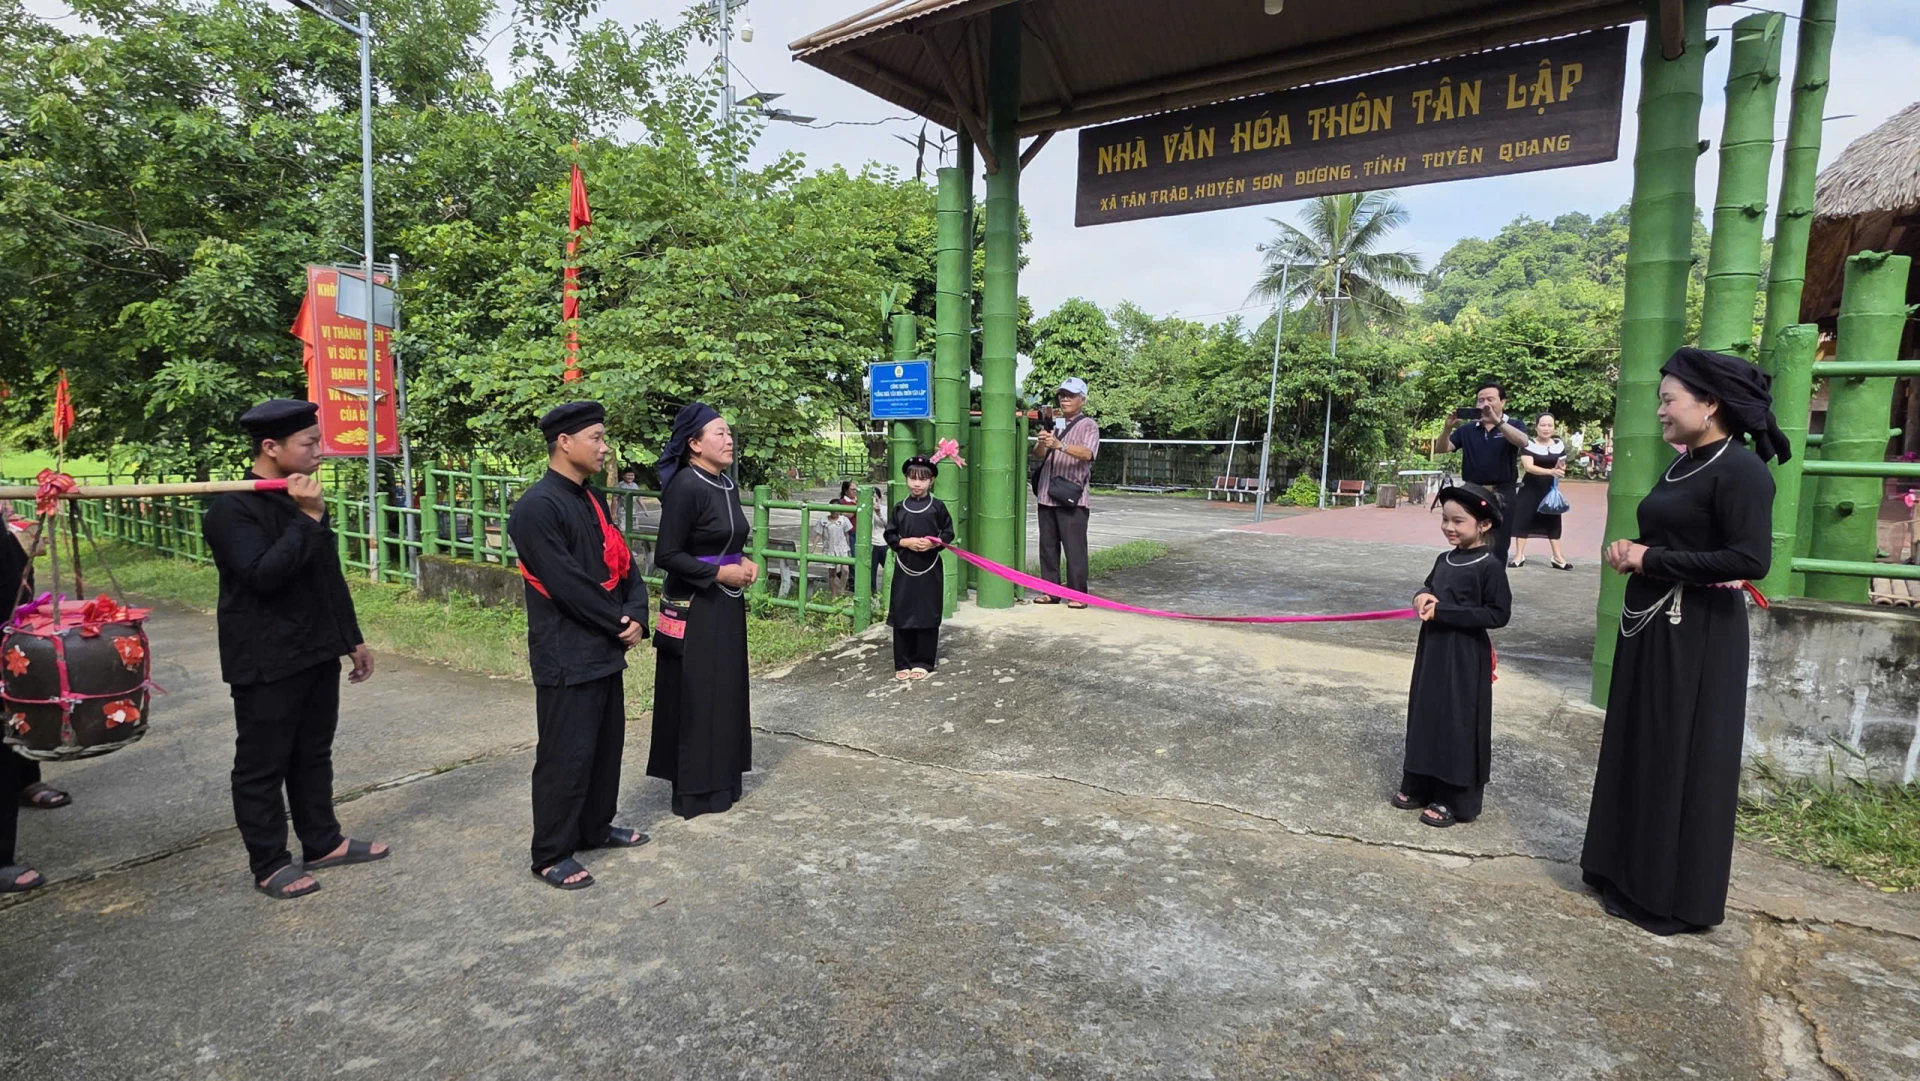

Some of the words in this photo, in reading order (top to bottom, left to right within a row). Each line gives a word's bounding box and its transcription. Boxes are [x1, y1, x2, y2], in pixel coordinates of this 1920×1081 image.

[1098, 136, 1147, 175] NHÀ
[1163, 123, 1215, 164] VĂN
[1230, 110, 1291, 153] HÓA
[1308, 92, 1393, 141] THÔN
[1412, 76, 1482, 124] TÂN
[1506, 58, 1583, 115] LẬP
[1100, 194, 1117, 211] XÃ
[1121, 191, 1146, 208] TÂN
[1252, 172, 1283, 191] SƠN
[1364, 154, 1406, 176] TỈNH
[1422, 146, 1483, 168] TUYÊN
[1499, 135, 1571, 162] QUANG
[321, 325, 331, 341] VỊ
[332, 324, 361, 341] THÀNH
[327, 345, 337, 359] VÌ
[338, 345, 357, 361] SỨC
[331, 367, 356, 383] HẠNH
[357, 368, 380, 382] PHC
[340, 405, 358, 422] CỦA
